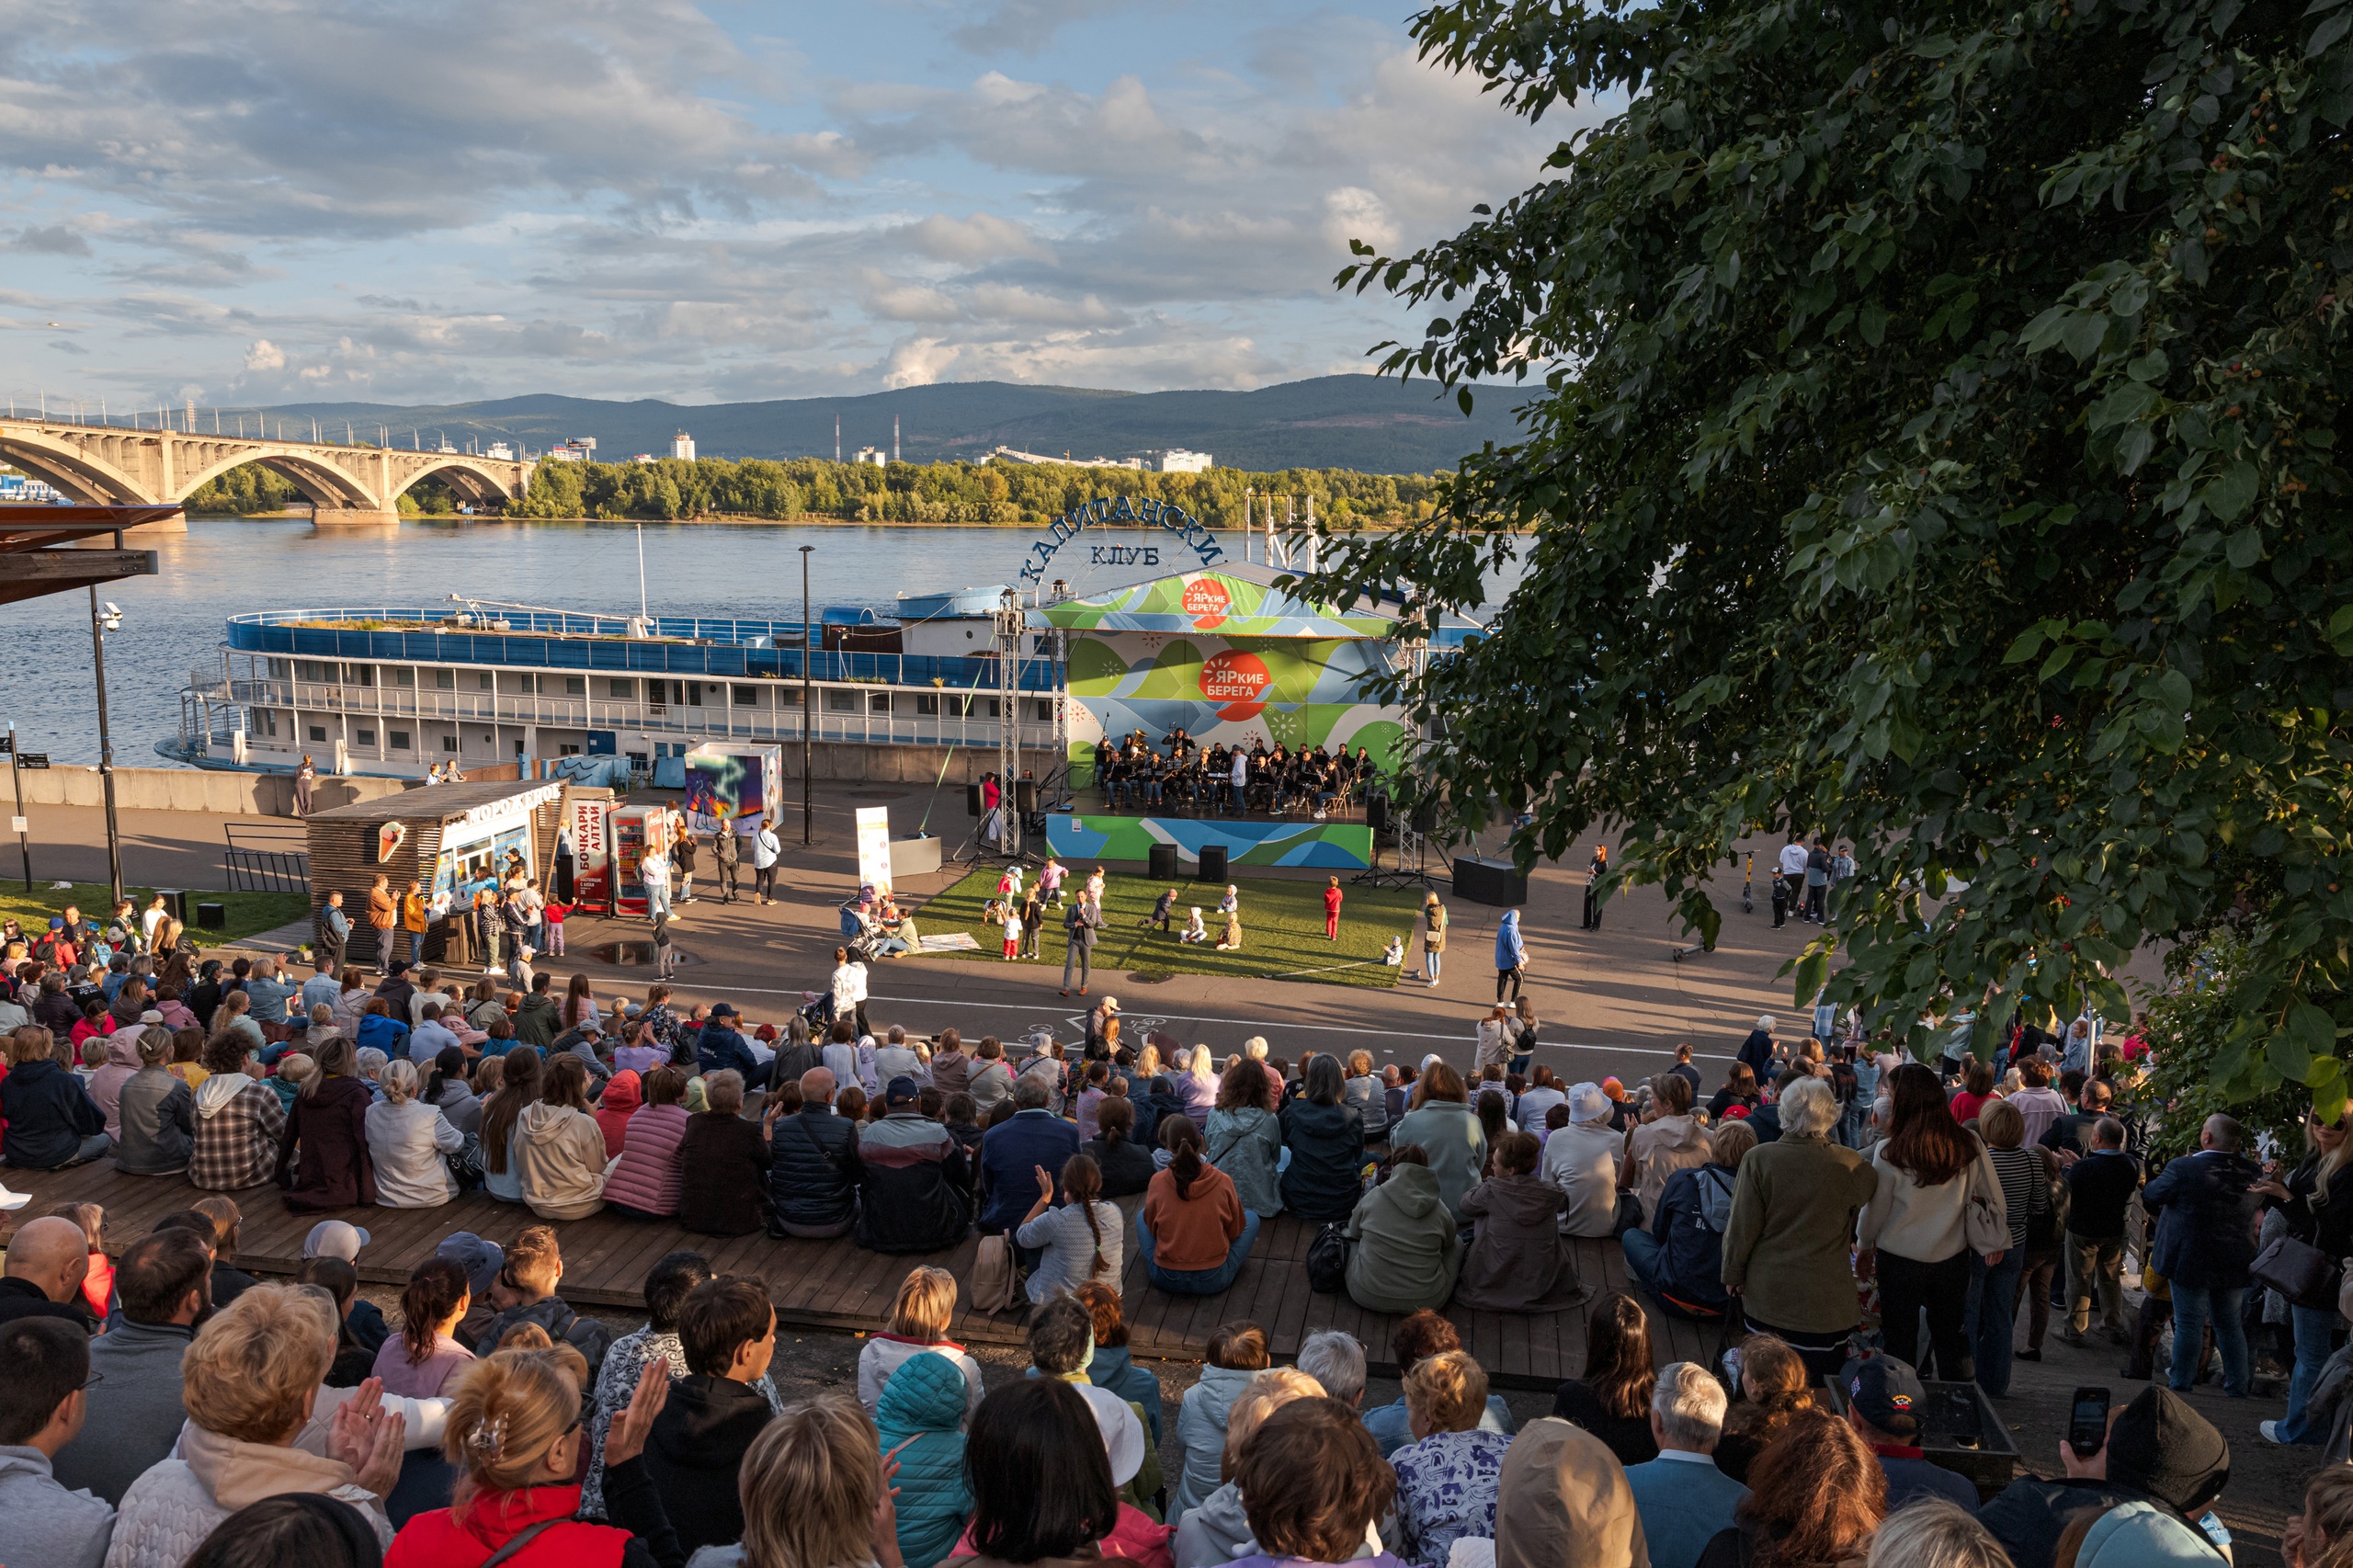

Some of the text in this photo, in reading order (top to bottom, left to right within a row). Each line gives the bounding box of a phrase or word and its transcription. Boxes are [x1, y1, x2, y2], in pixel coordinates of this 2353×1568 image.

[1020, 496, 1228, 585] КАПИТАНСКИ
[1091, 546, 1160, 565] КЛУБ
[1187, 603, 1220, 611] БЕРЕГА
[1207, 685, 1255, 697] БЕРЕГА
[465, 782, 561, 825] МОРОЖЕНОЕ
[578, 805, 590, 870] БОЧКАРИ
[589, 806, 600, 851] АЛТАЙ
